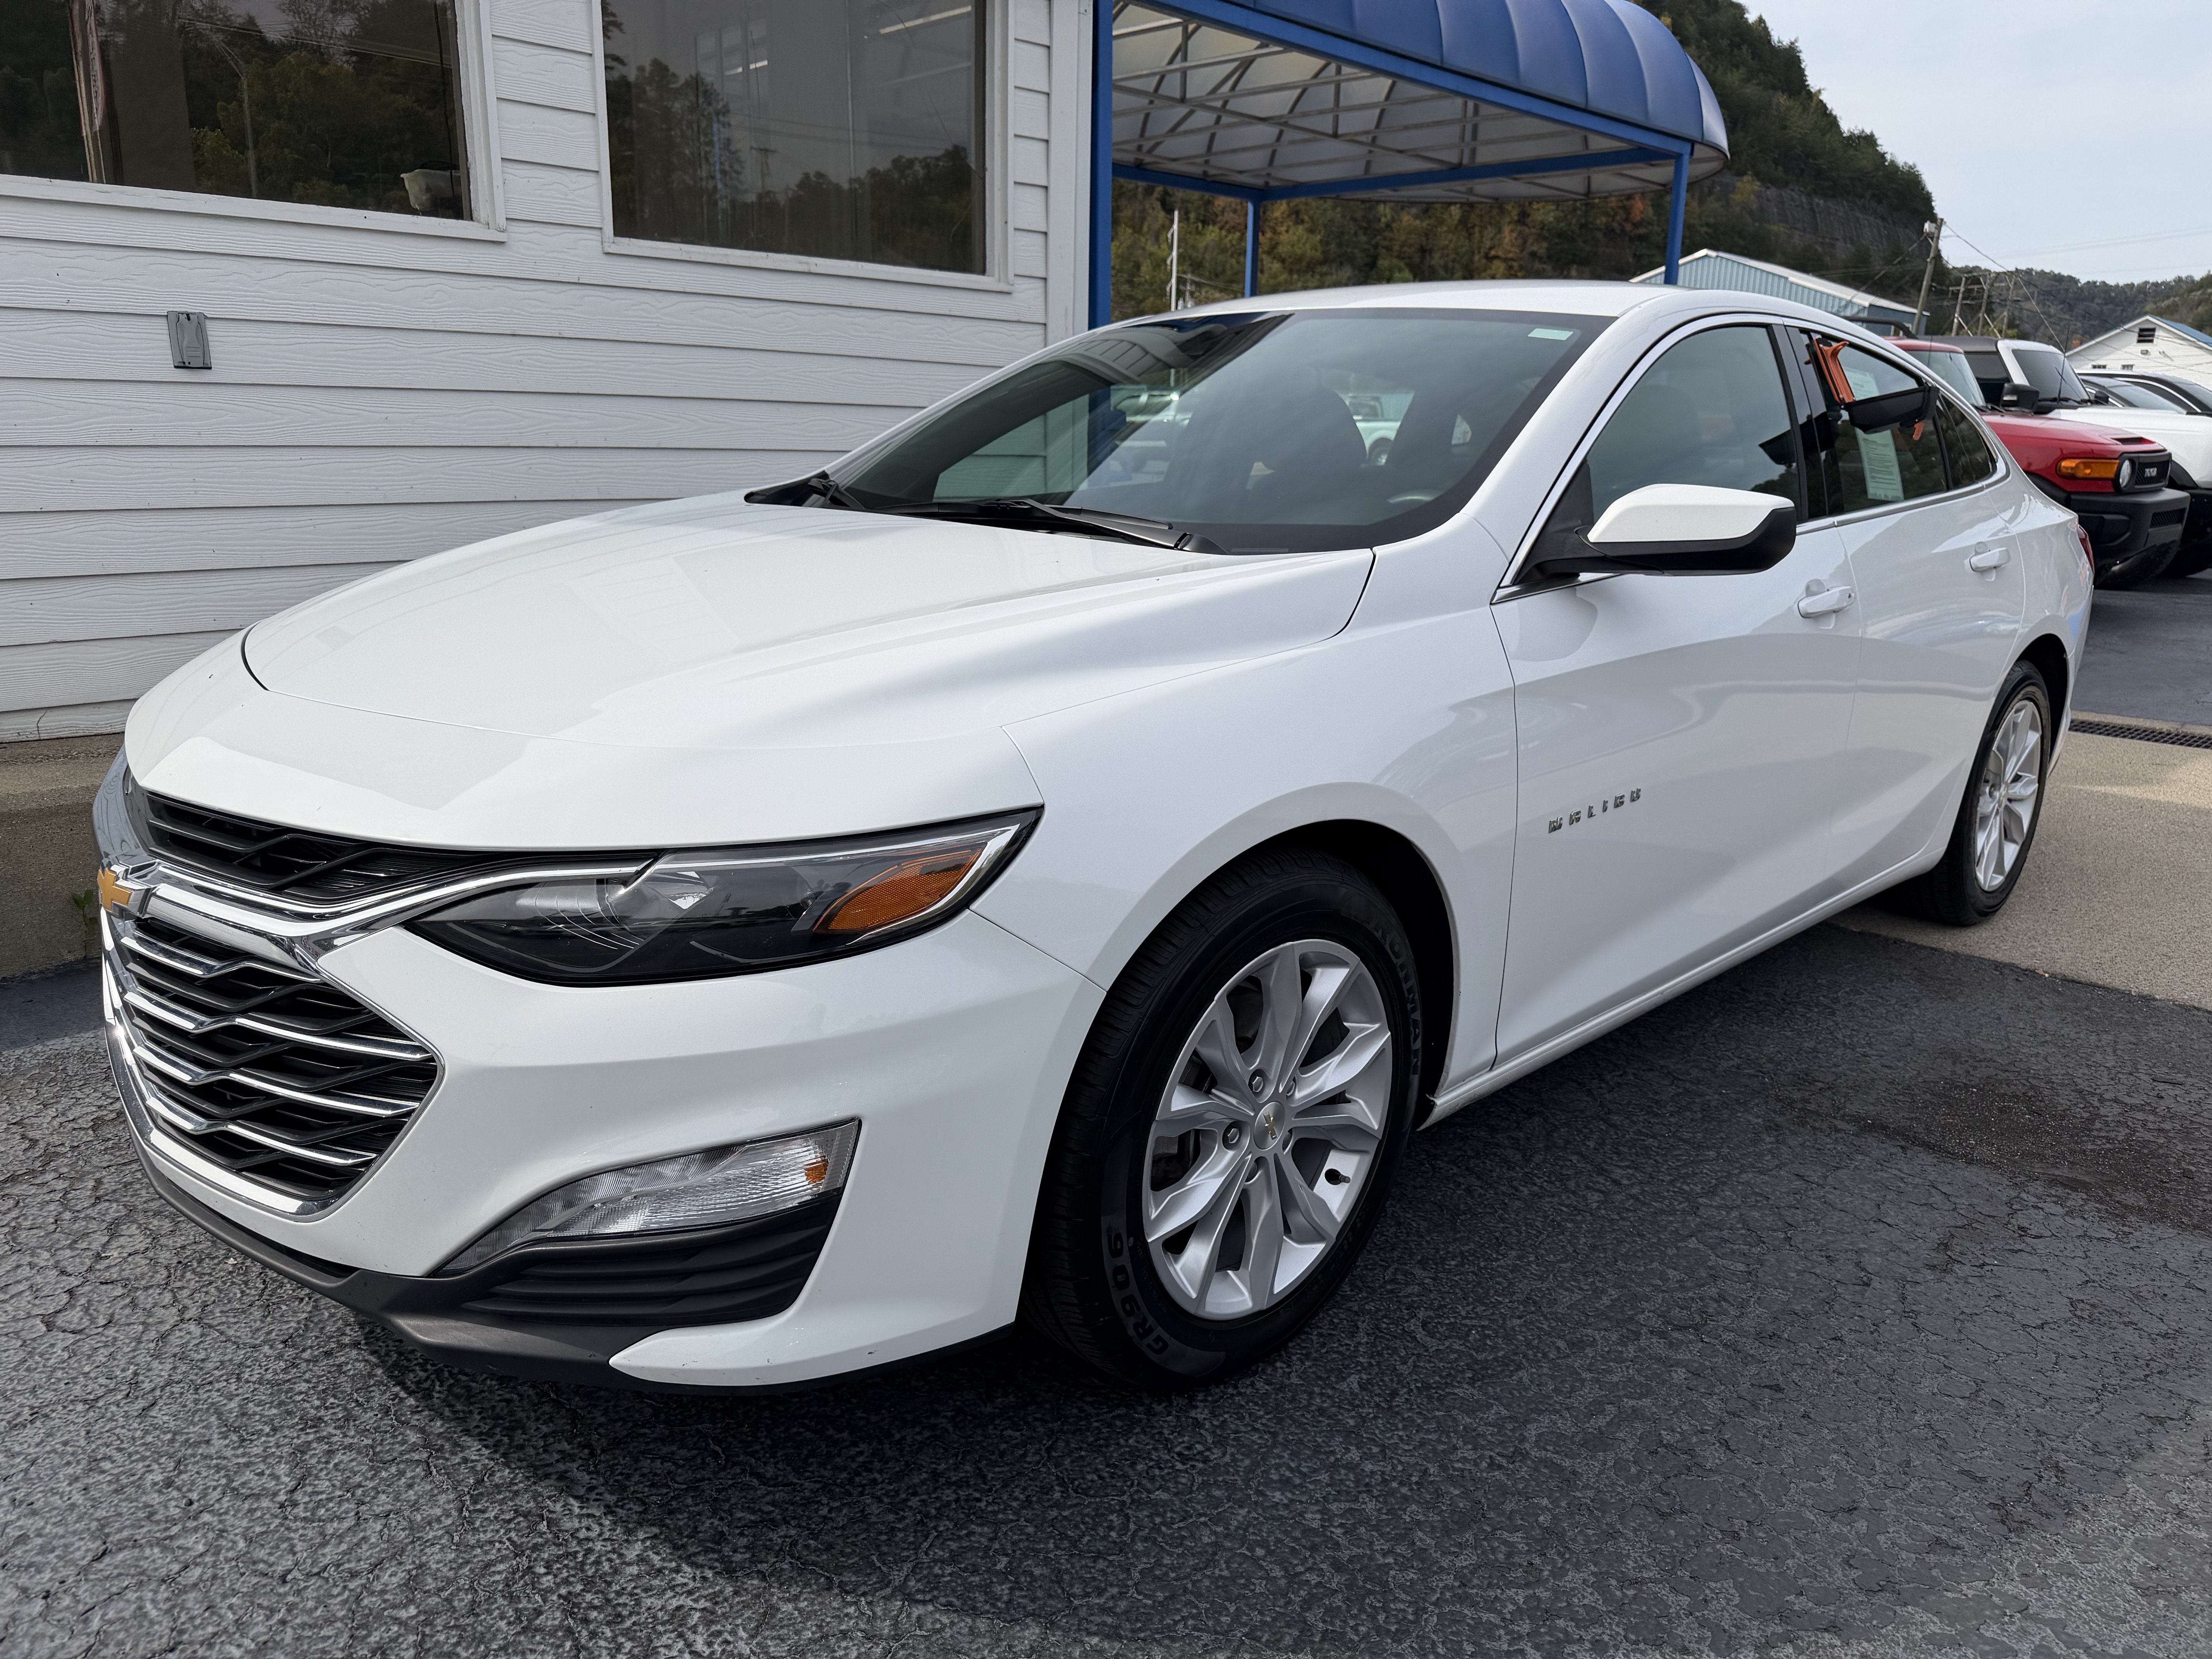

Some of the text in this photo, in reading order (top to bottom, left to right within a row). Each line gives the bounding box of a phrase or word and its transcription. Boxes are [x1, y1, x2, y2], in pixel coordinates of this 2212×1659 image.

[1548, 787, 1641, 833] MALIBU
[1364, 908, 1421, 1075] IRONMAN
[1107, 1232, 1169, 1355] GR906
